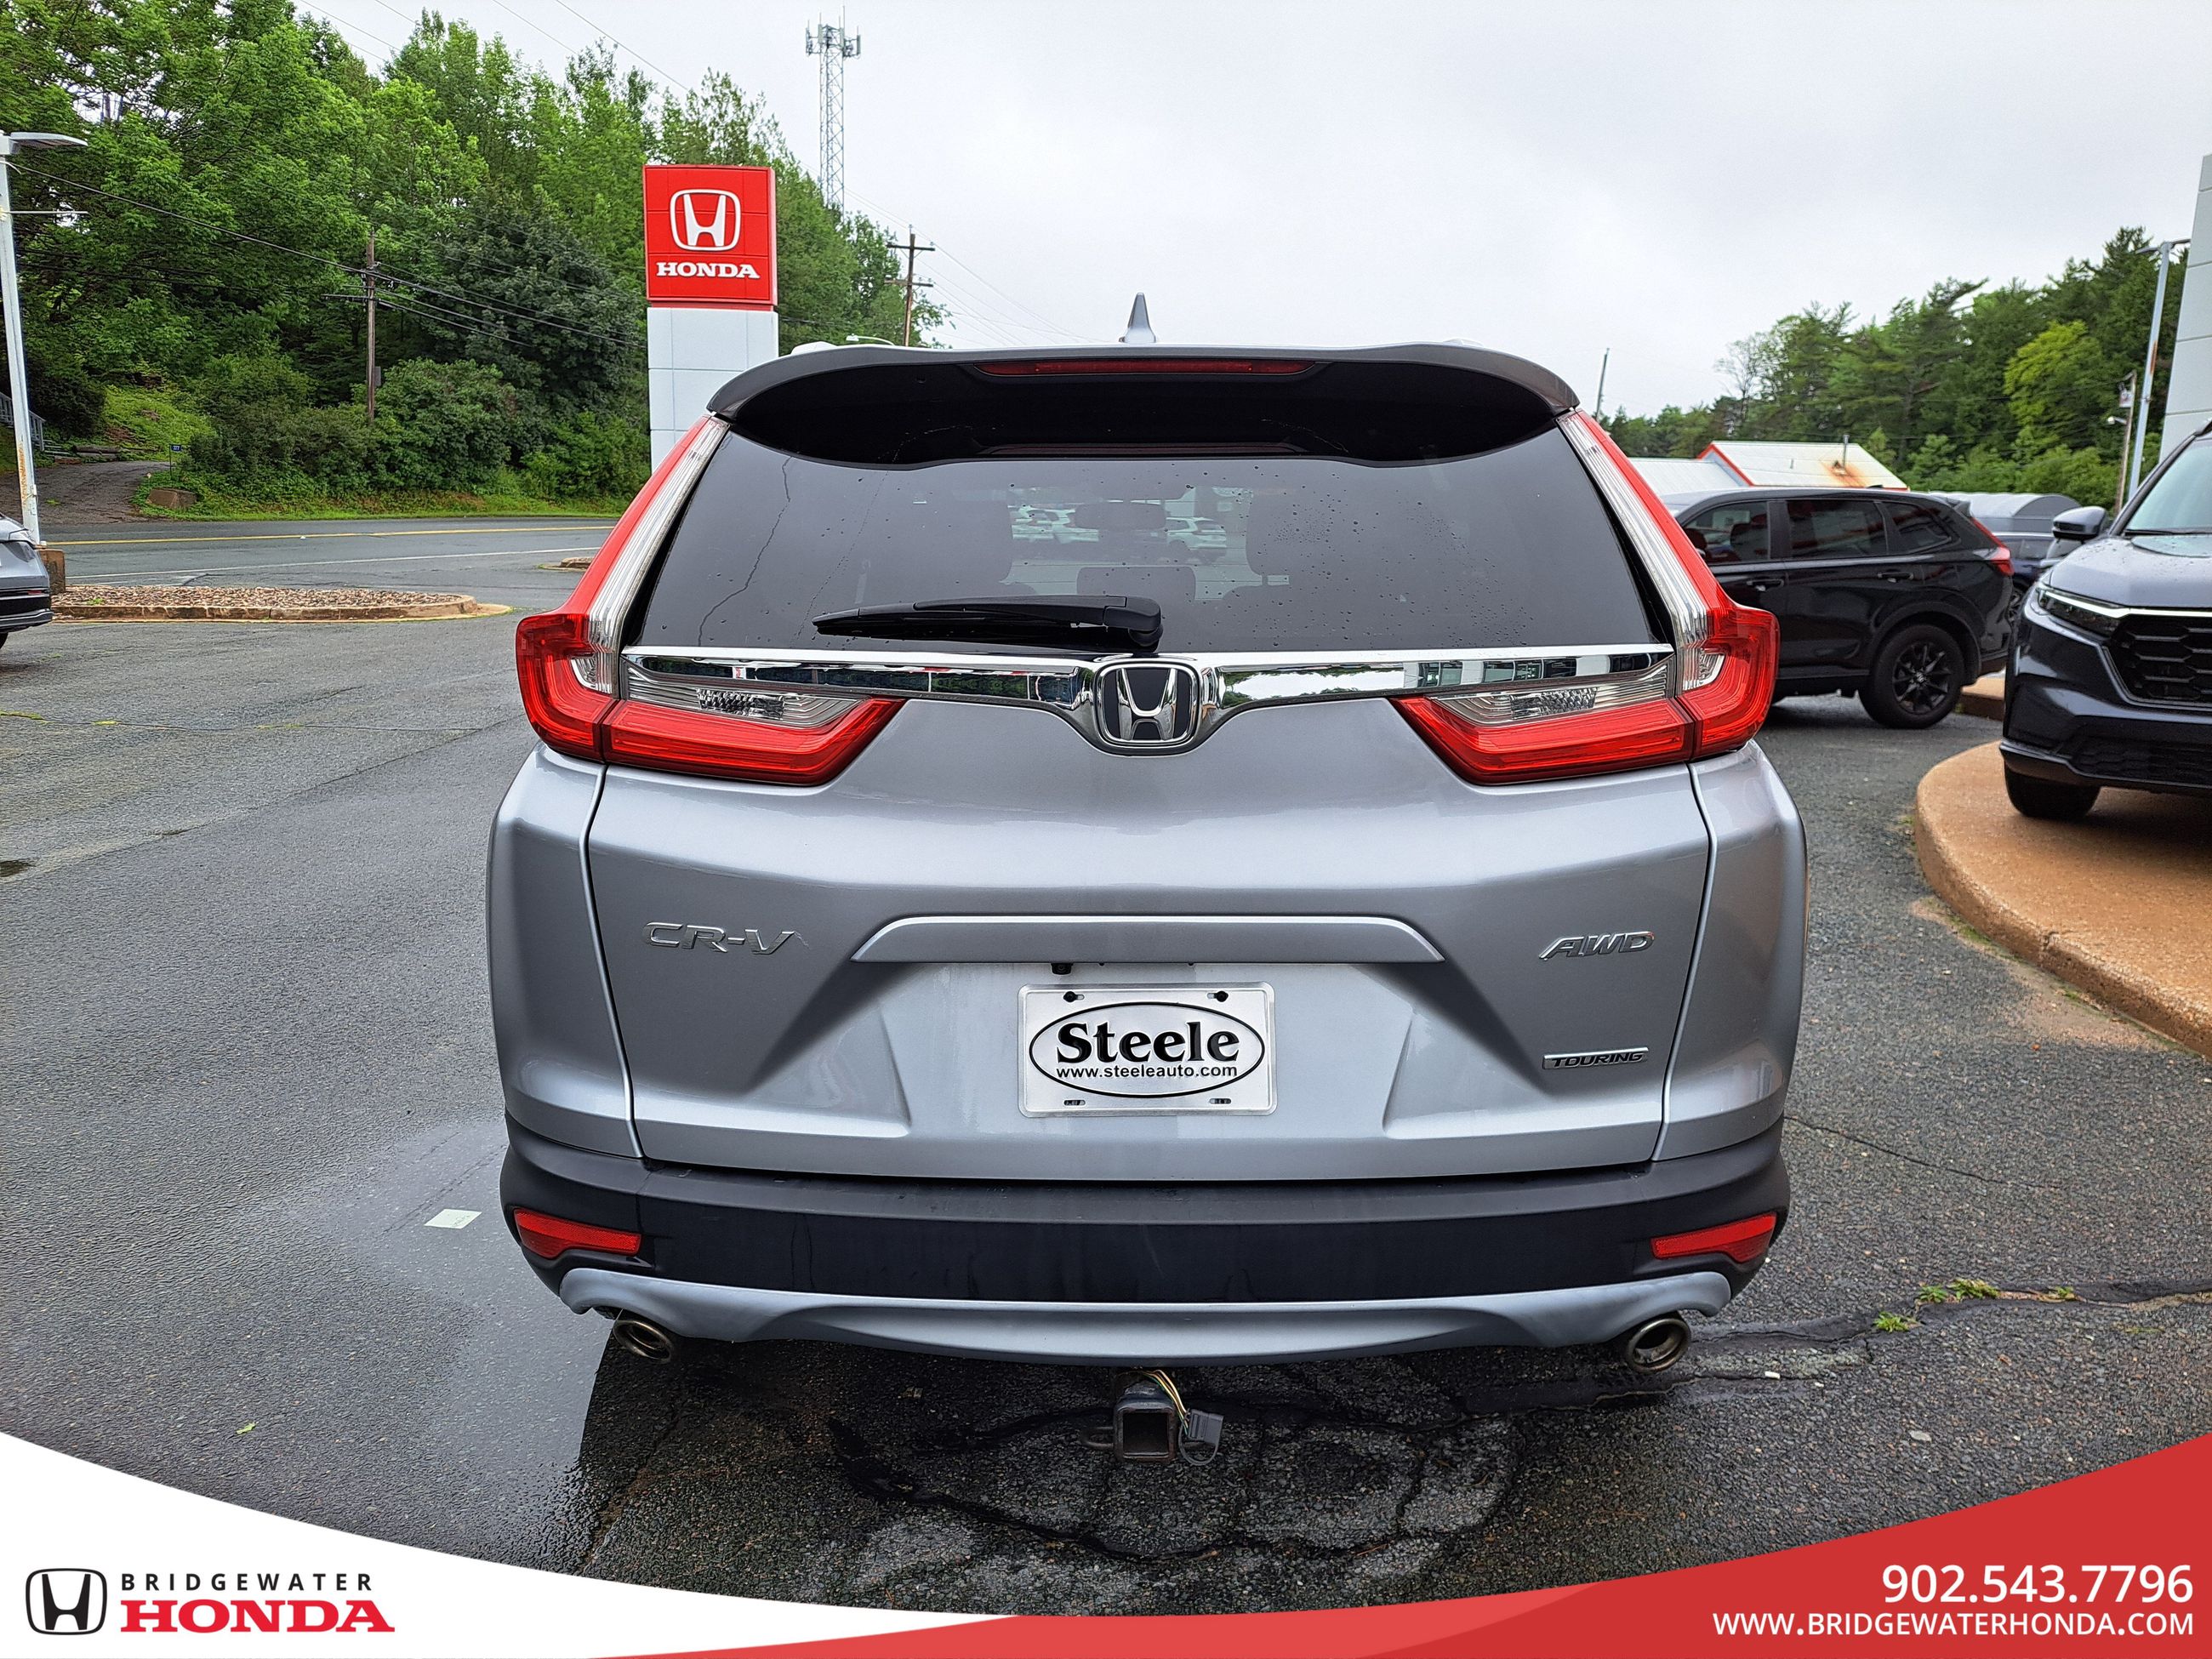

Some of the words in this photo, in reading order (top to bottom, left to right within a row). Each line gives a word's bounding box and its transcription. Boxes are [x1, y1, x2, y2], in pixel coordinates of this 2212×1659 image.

[656, 262, 760, 279] HONDA
[642, 921, 795, 955] CR-V
[1538, 931, 1655, 961] AWD
[1056, 1021, 1240, 1063] Steele
[1056, 1064, 1238, 1078] www.steeleauto.com
[1551, 1051, 1644, 1068] TOURING
